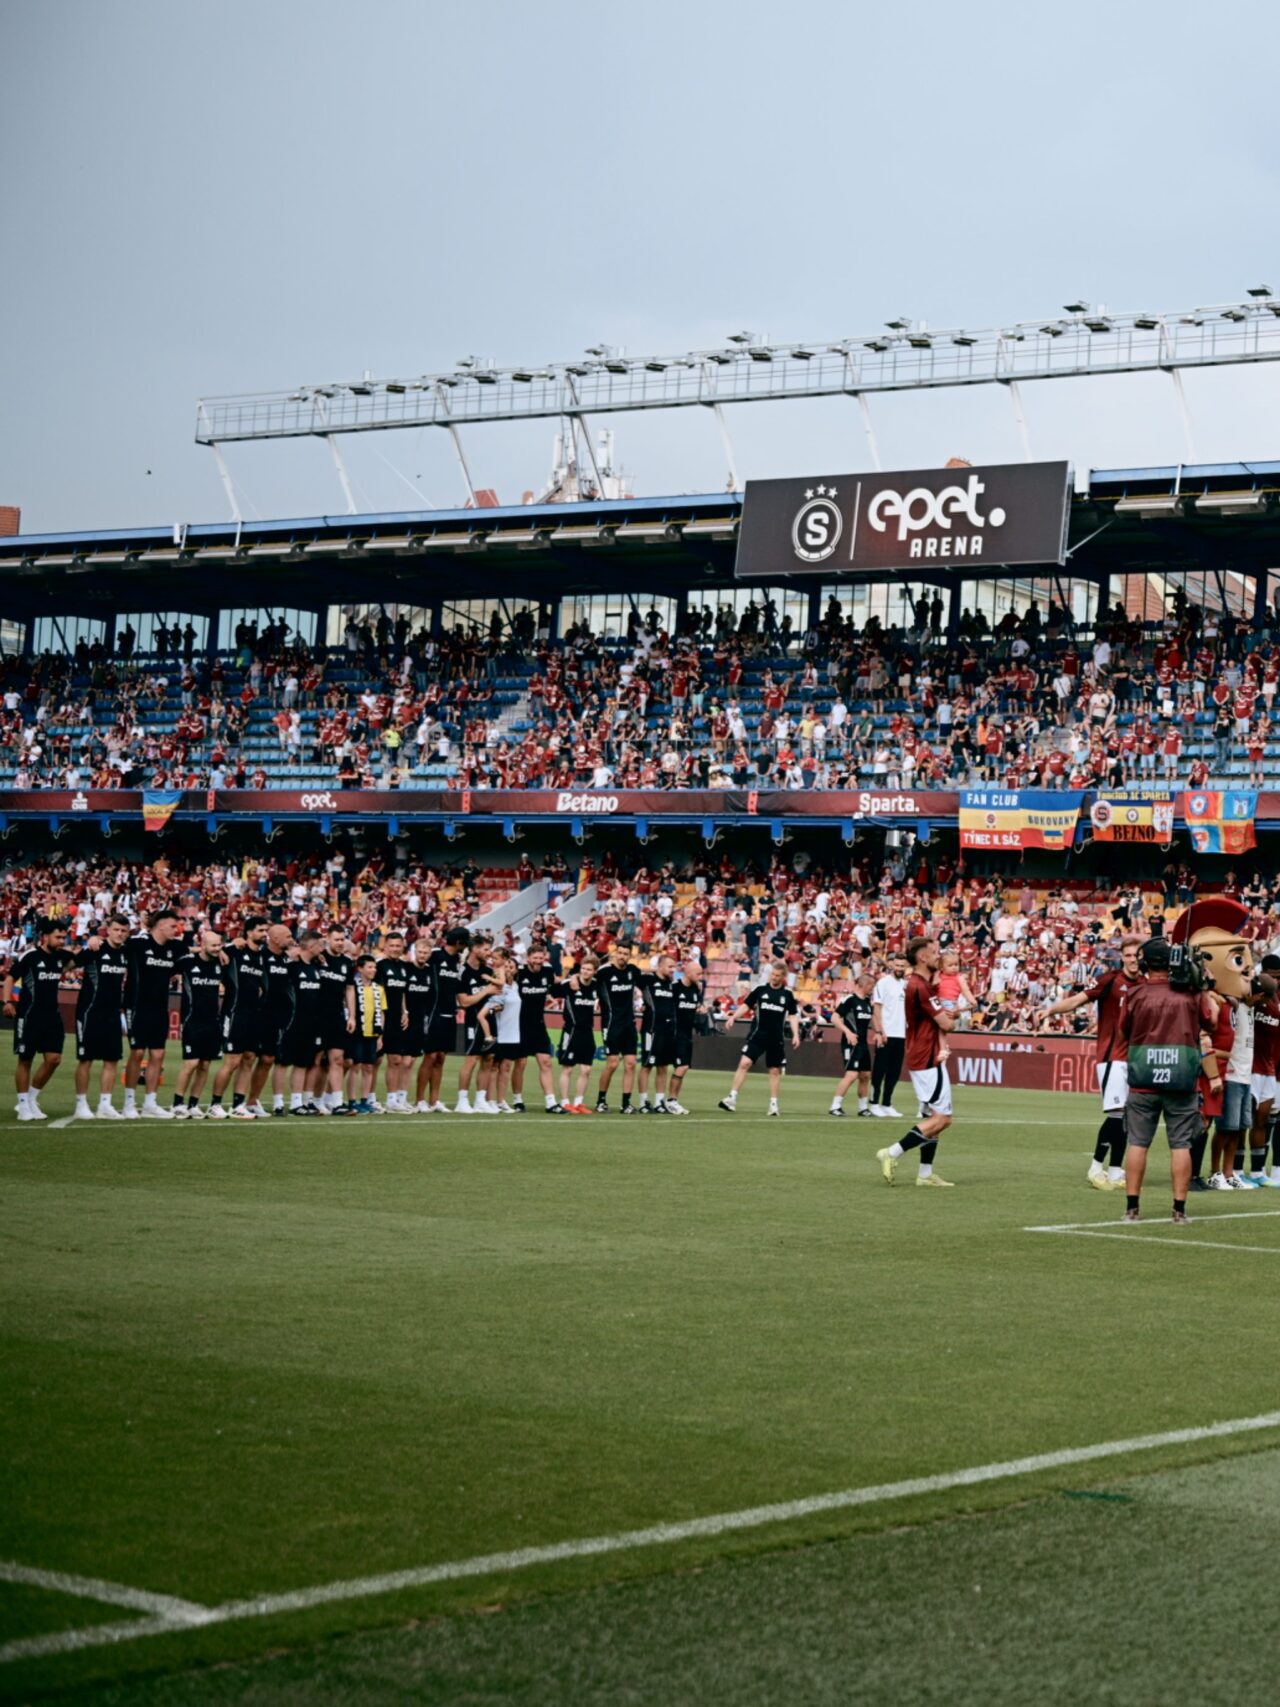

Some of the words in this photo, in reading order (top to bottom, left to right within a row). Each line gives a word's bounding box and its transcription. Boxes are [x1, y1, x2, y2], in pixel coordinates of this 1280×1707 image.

[868, 475, 1006, 540] epet.
[805, 511, 829, 546] S
[910, 535, 983, 558] ARENA
[301, 792, 337, 811] epet.
[557, 792, 619, 812] Betano
[859, 793, 920, 813] Sparta.
[967, 793, 987, 805] FAN
[992, 794, 1018, 806] CLUB
[1146, 1048, 1179, 1066] PITCH
[958, 1056, 1003, 1084] WIN
[1152, 1068, 1171, 1084] 223
